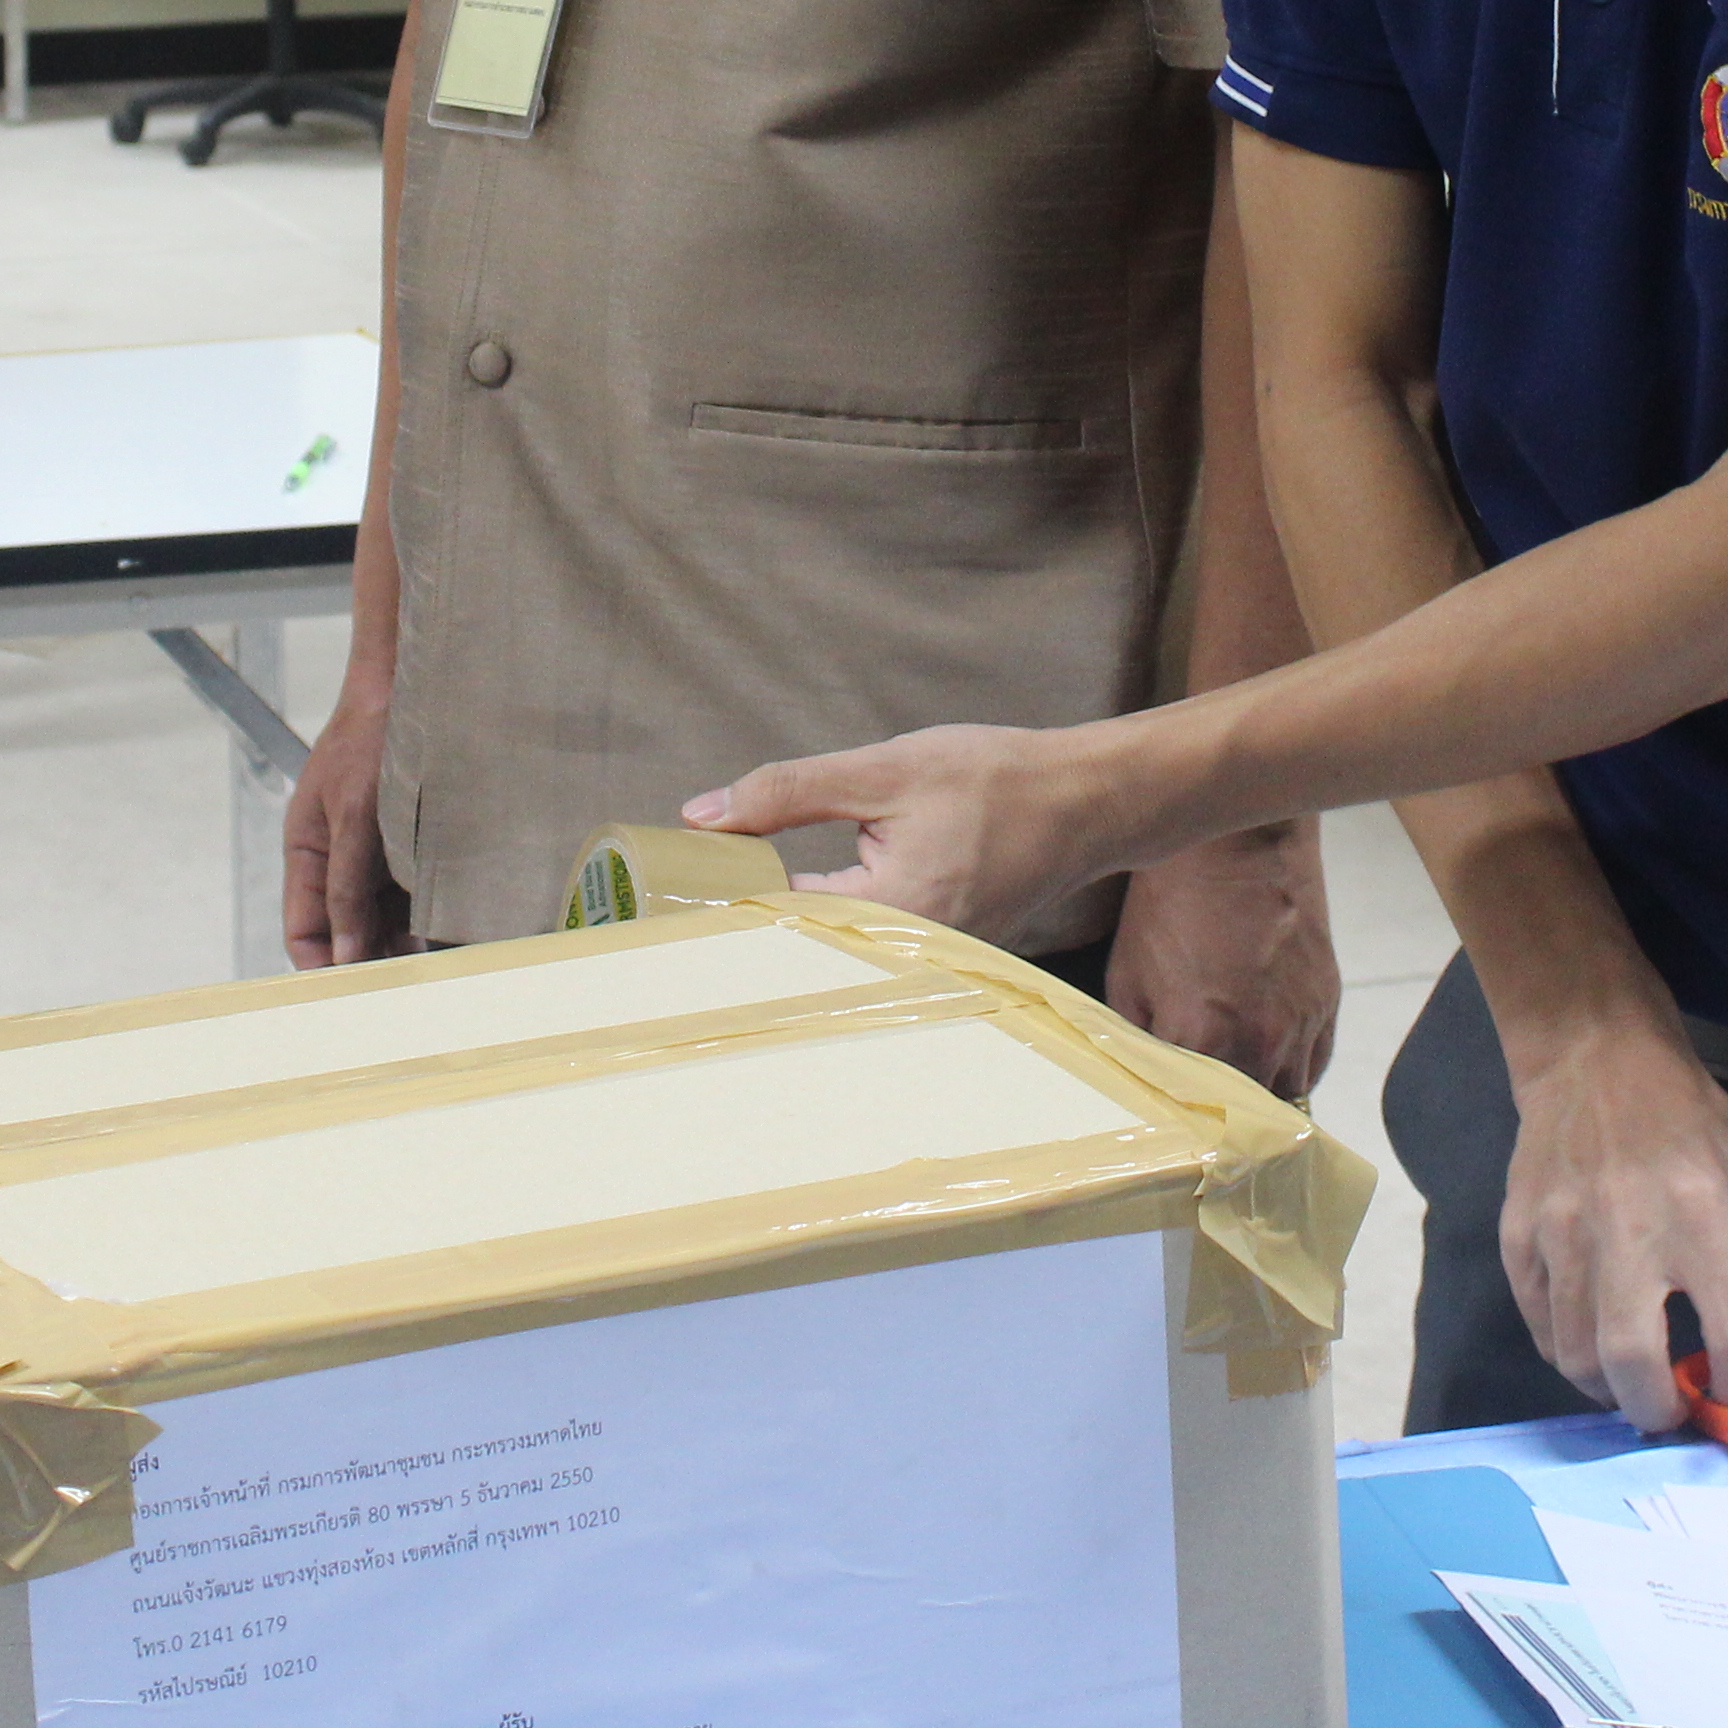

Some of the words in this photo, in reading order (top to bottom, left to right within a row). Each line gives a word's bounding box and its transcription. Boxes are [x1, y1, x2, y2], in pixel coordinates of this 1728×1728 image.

[277, 1451, 446, 1494] กรมการพัฒนาชุมชน
[451, 1418, 603, 1463] กระทรวงมหาดไทย
[129, 1506, 361, 1573] ศูนย์ราชการเฉลิมพระเกียรติ
[368, 1504, 391, 1523] 80
[396, 1494, 454, 1519] พรรษา
[460, 1488, 472, 1507] 5
[477, 1477, 544, 1504] ธันวาคม
[550, 1466, 594, 1491] 2550
[132, 1577, 256, 1614] ถนนแจ้งวัฒนะ
[262, 1547, 395, 1589] แขวงทุ่งสองห้อง
[402, 1524, 479, 1564] เขตหลักสี่
[485, 1520, 560, 1551] กรุงเทพฯ
[568, 1506, 621, 1532] 10210
[132, 1634, 184, 1659] โทร.0
[190, 1625, 235, 1650] 2141
[242, 1614, 288, 1639] 6179
[138, 1662, 248, 1705] รหัสไปรษณีย์
[264, 1655, 318, 1682] 10210
